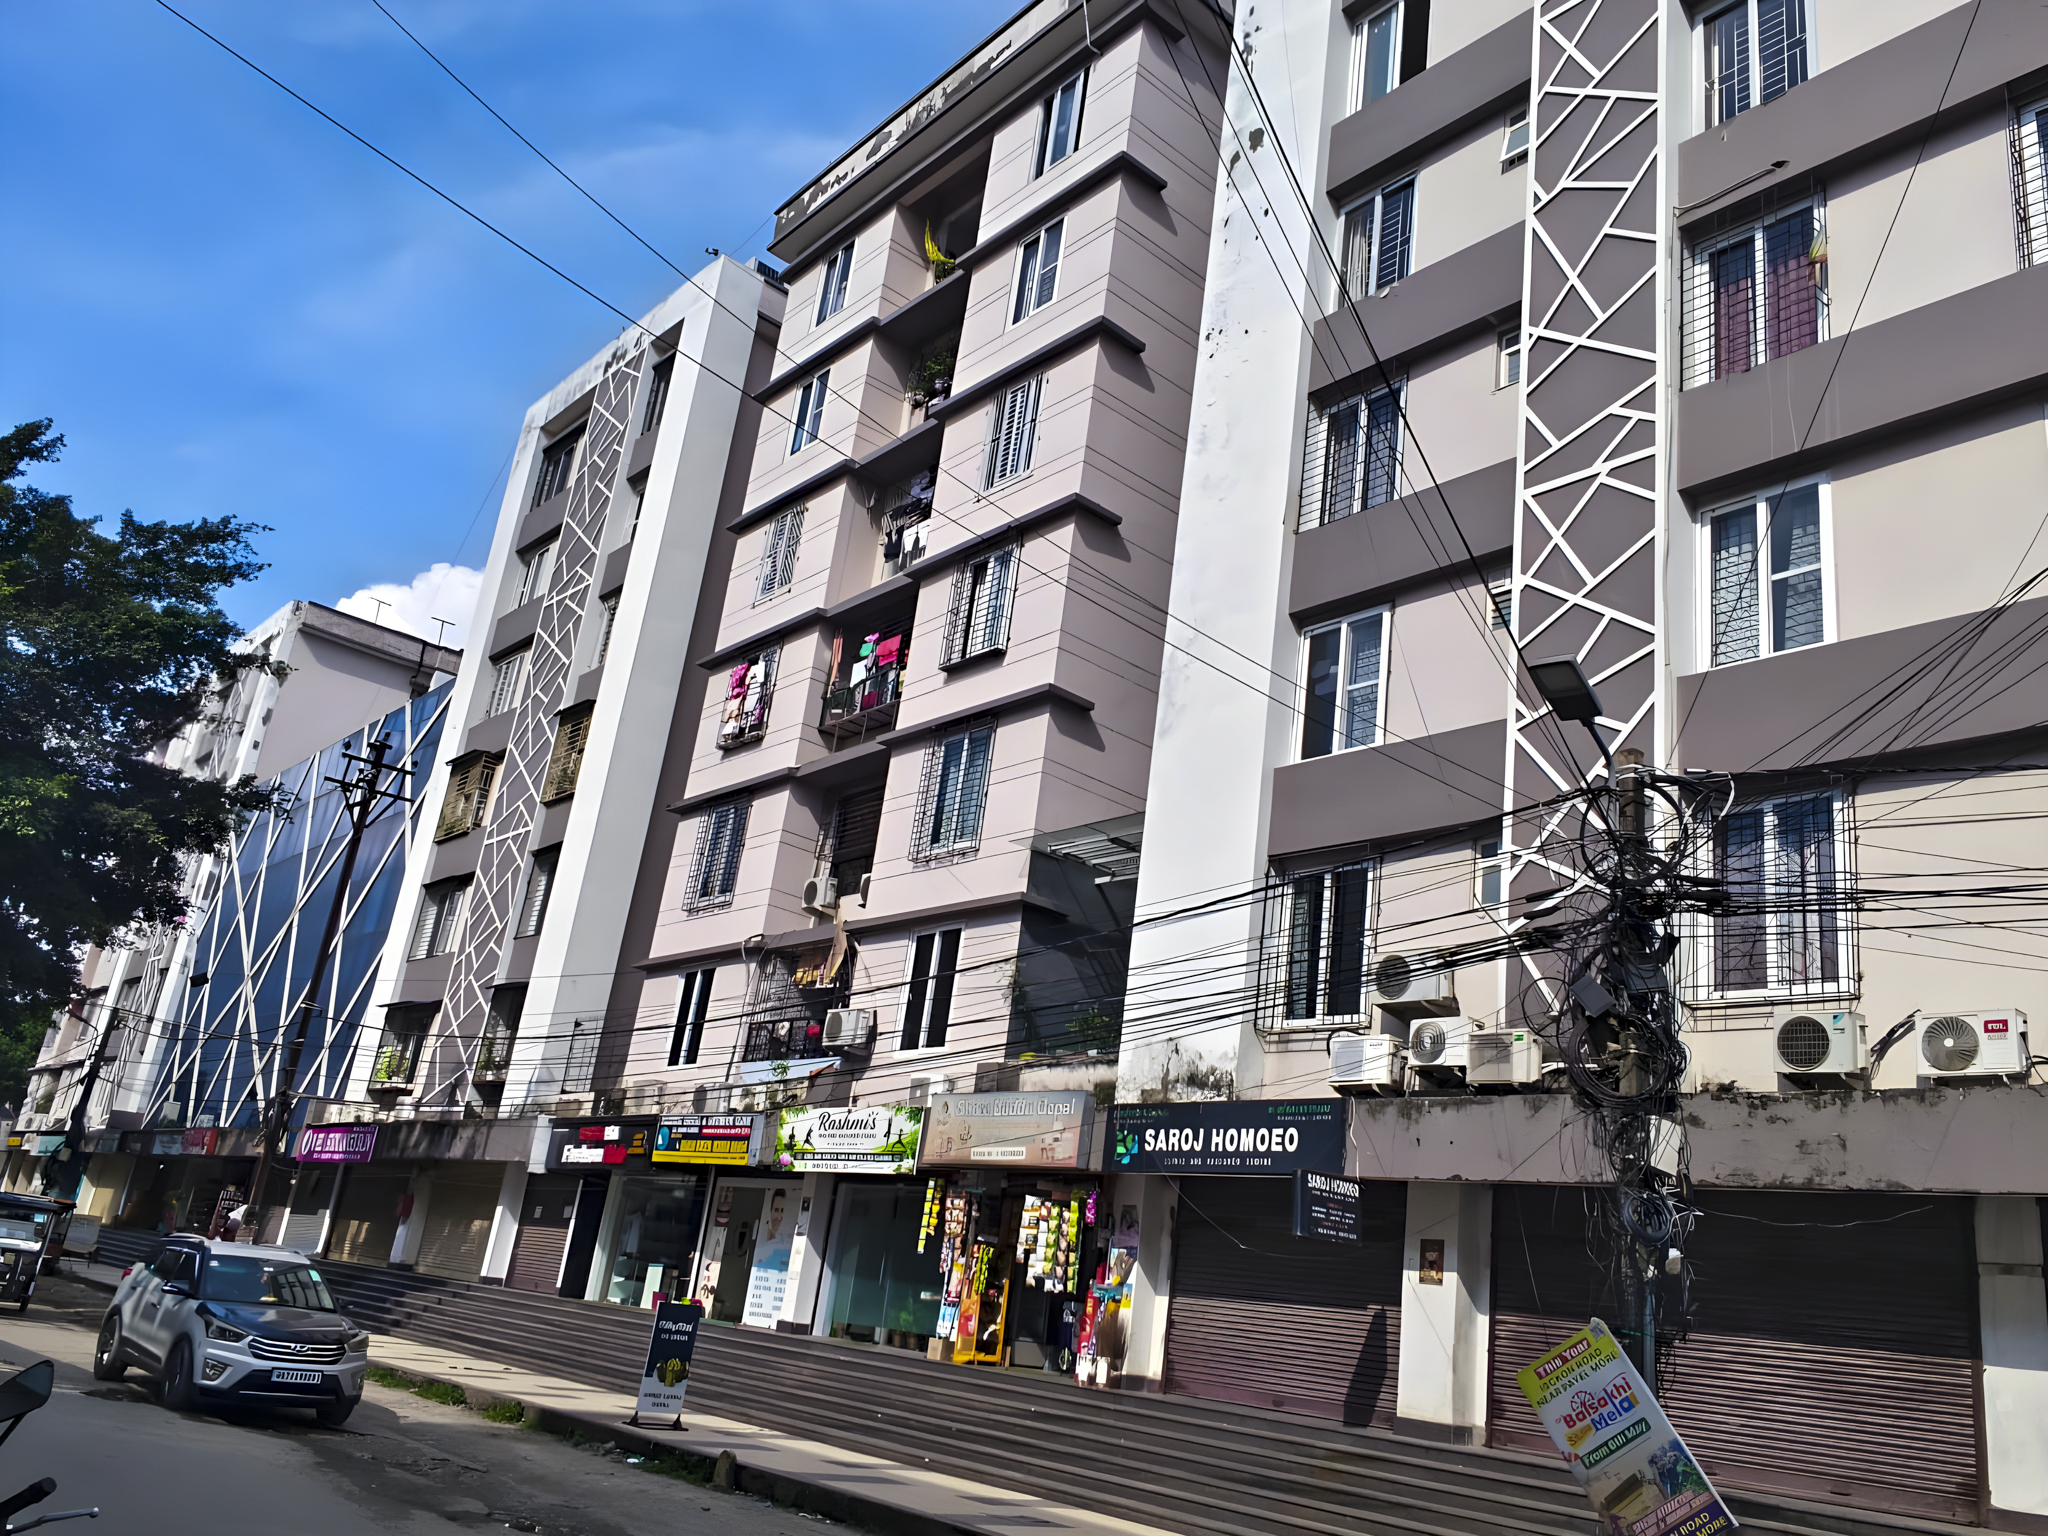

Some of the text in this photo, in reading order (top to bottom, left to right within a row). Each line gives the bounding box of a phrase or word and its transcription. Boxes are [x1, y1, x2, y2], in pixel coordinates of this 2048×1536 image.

[1144, 1127, 1299, 1152] SAROJ HOMOEO
[1590, 1389, 1636, 1433] Mela
